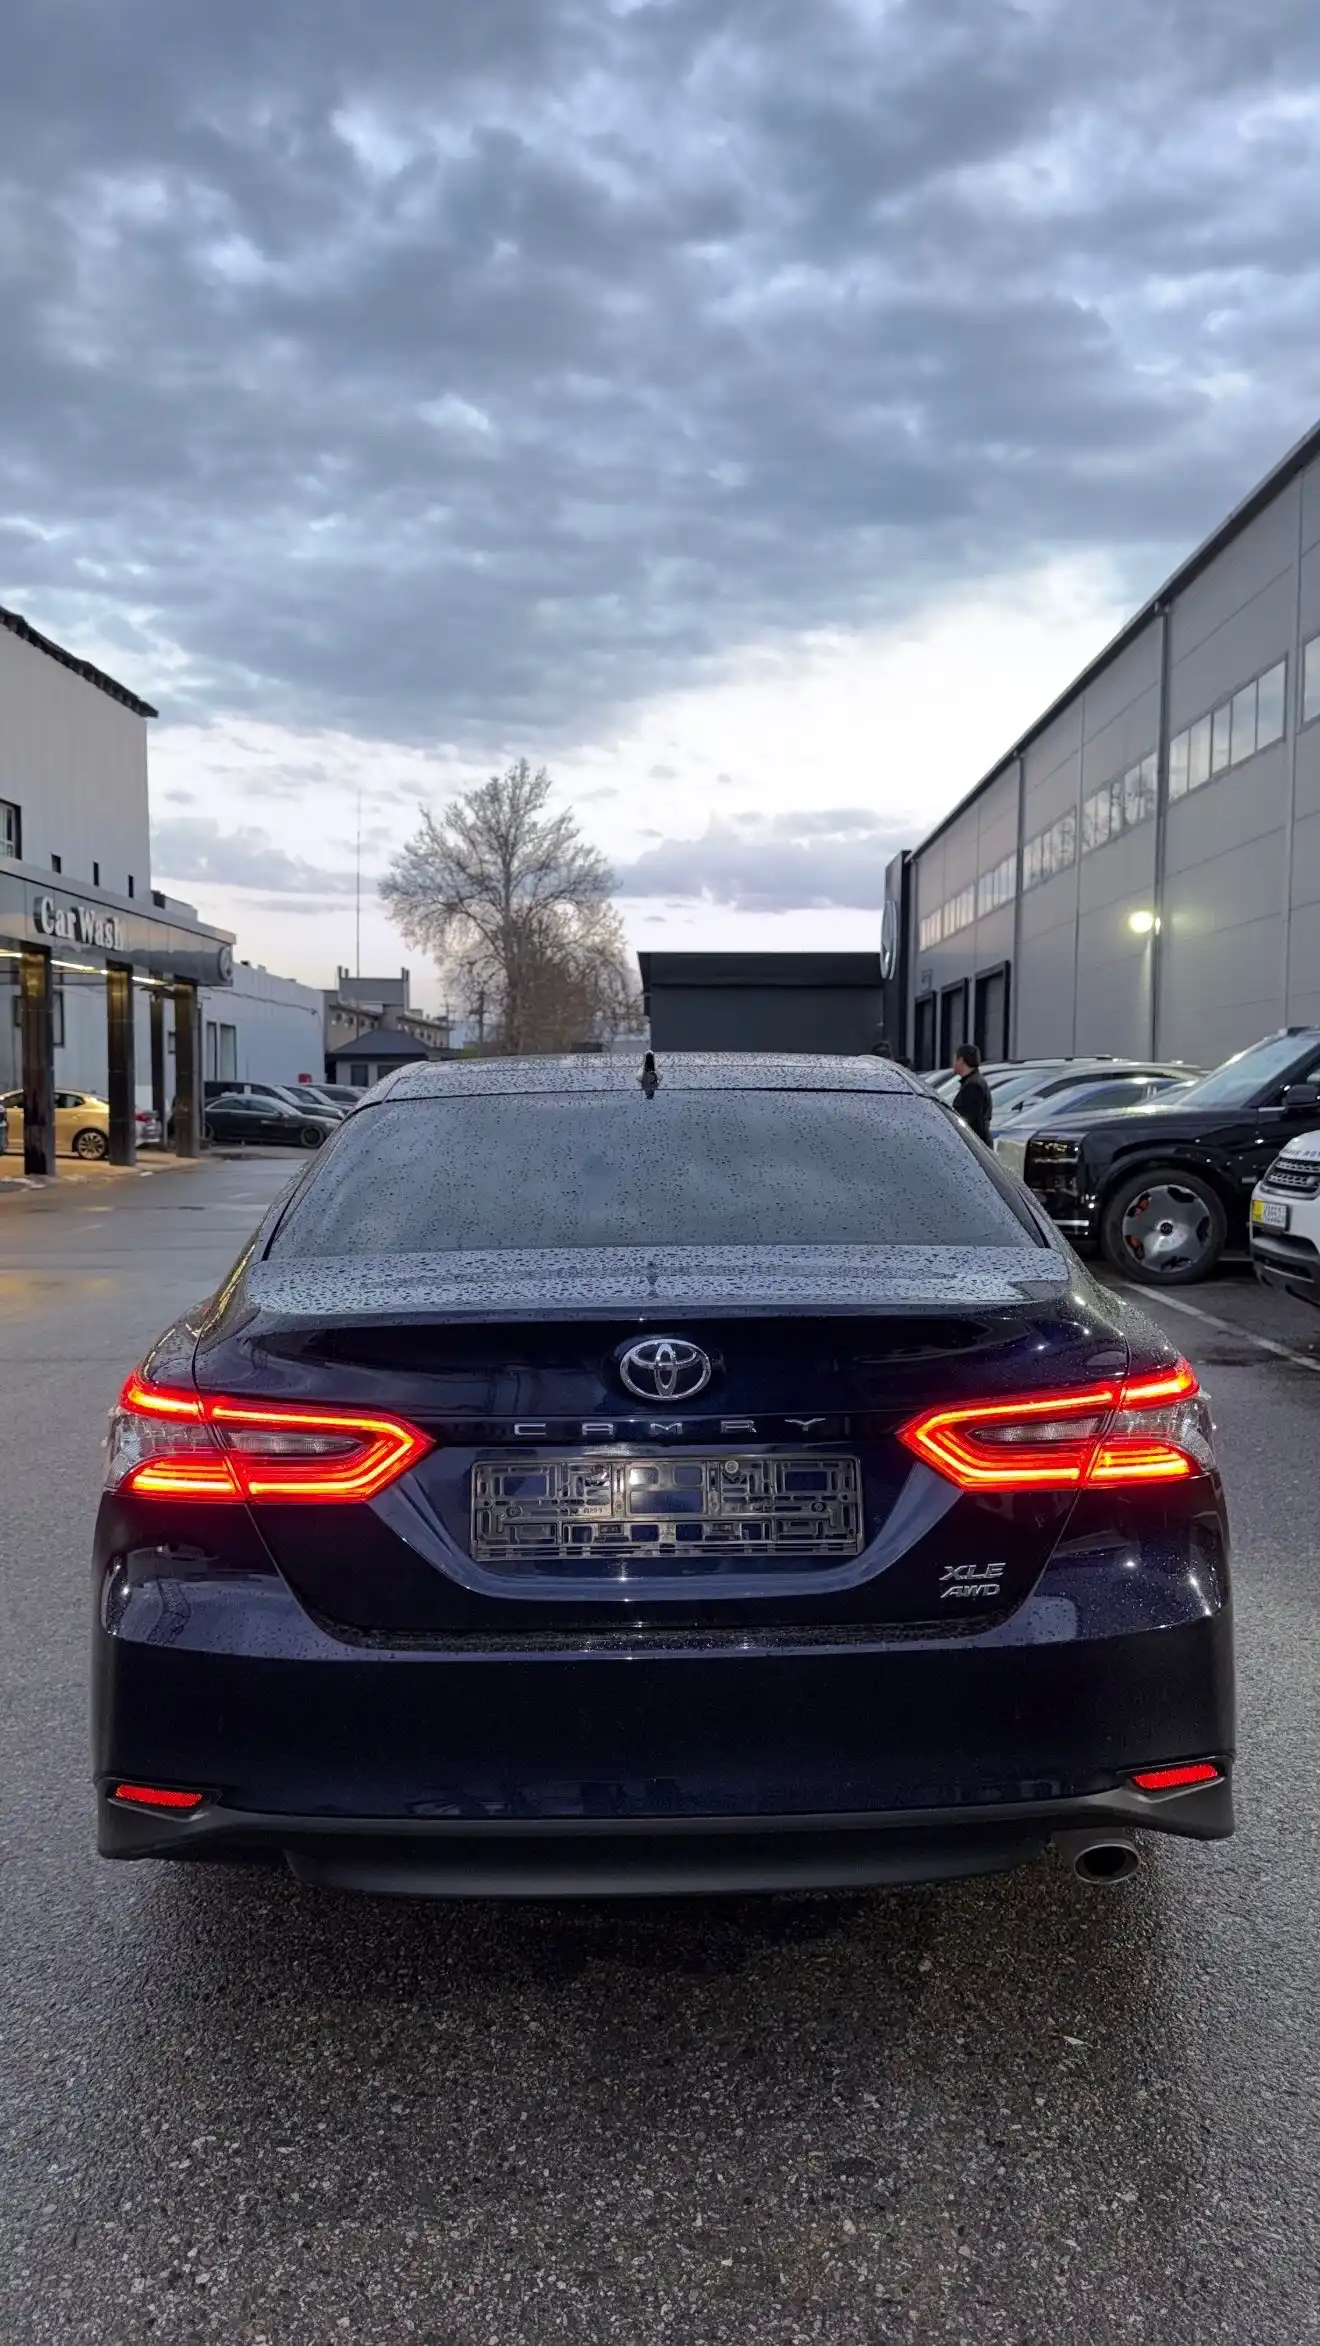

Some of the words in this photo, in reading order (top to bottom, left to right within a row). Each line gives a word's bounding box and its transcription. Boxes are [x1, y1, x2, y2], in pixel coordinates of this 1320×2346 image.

[40, 896, 77, 939] Car
[77, 906, 124, 951] Wash
[514, 1417, 827, 1435] CAMRY
[939, 1562, 1007, 1580] XLE
[940, 1583, 1001, 1599] AWD
